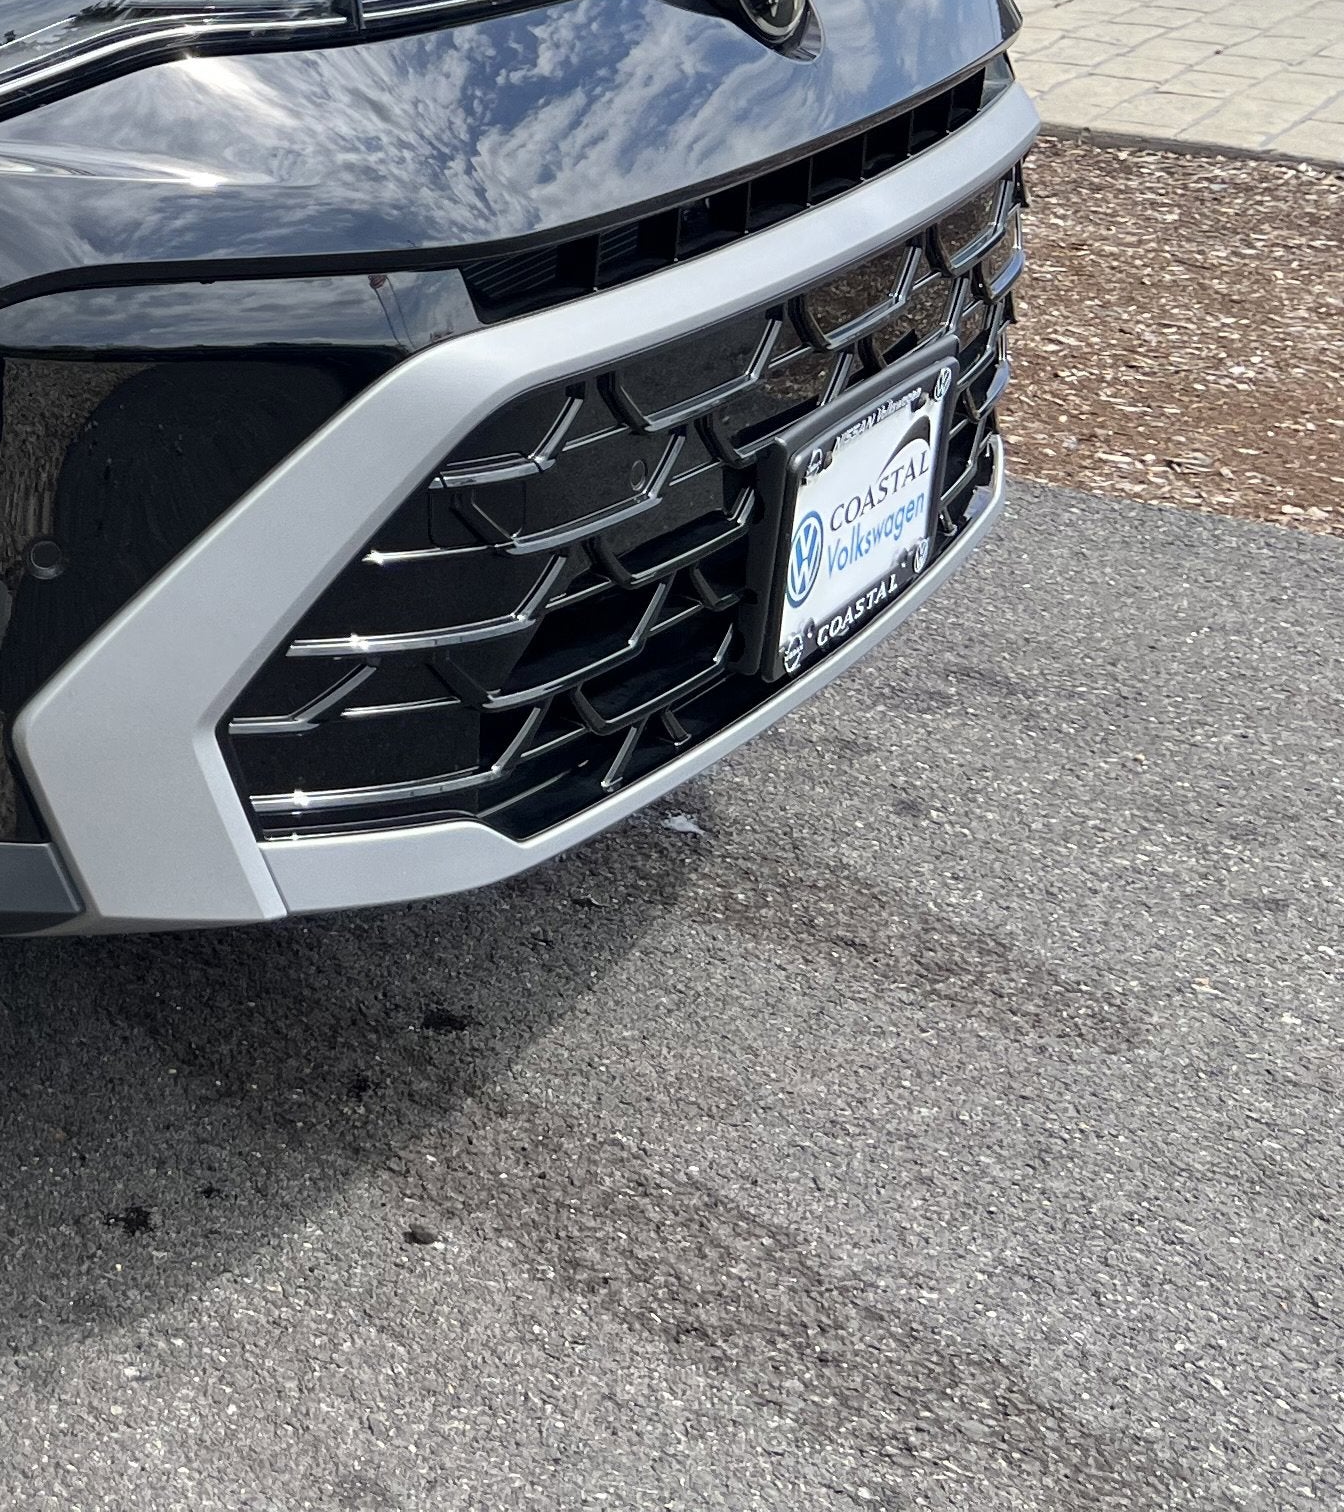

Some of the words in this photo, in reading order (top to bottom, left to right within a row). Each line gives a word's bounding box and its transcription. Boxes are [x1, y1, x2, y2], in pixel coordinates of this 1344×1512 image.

[829, 450, 929, 532] COASTAL
[827, 492, 925, 577] Volkswagen
[817, 573, 898, 646] COASTAL
